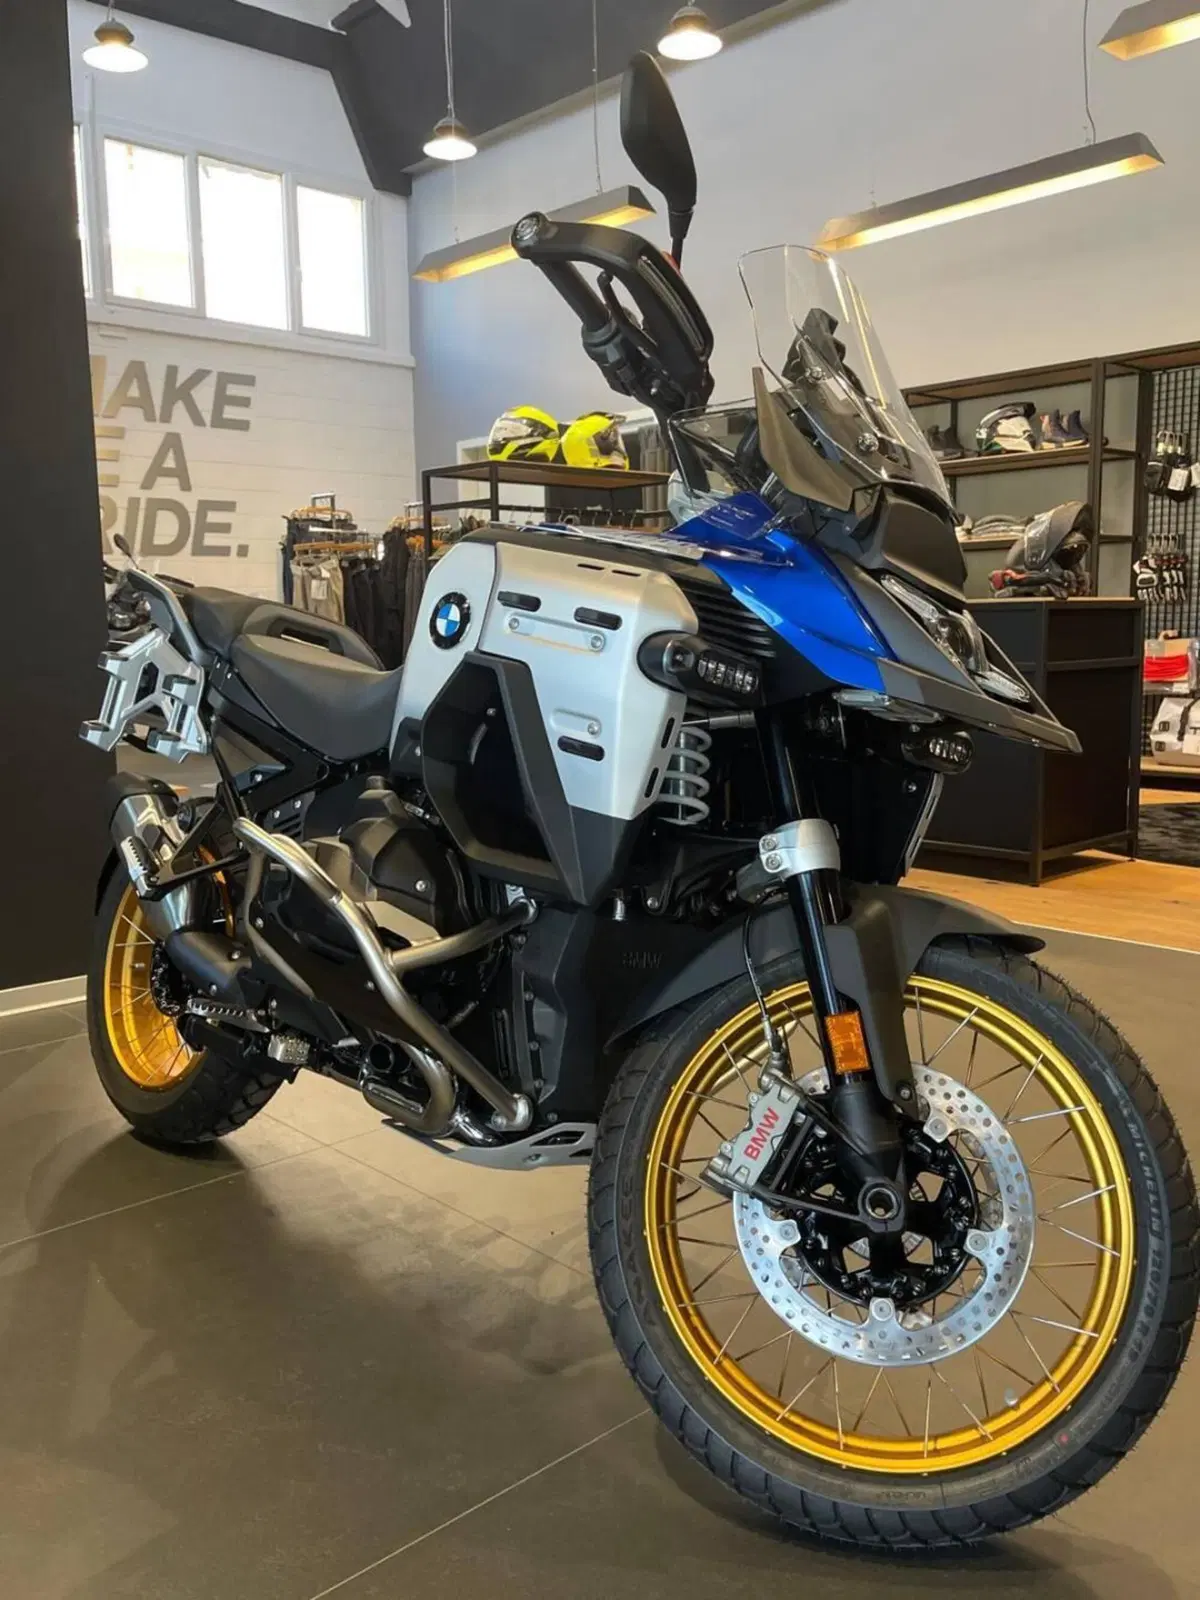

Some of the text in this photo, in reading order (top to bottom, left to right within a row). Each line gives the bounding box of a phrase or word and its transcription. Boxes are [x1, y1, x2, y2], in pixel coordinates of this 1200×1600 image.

[139, 431, 192, 492] A
[621, 951, 665, 969] BMW
[743, 1106, 780, 1161] BMW
[1128, 1122, 1163, 1232] MICHELIN
